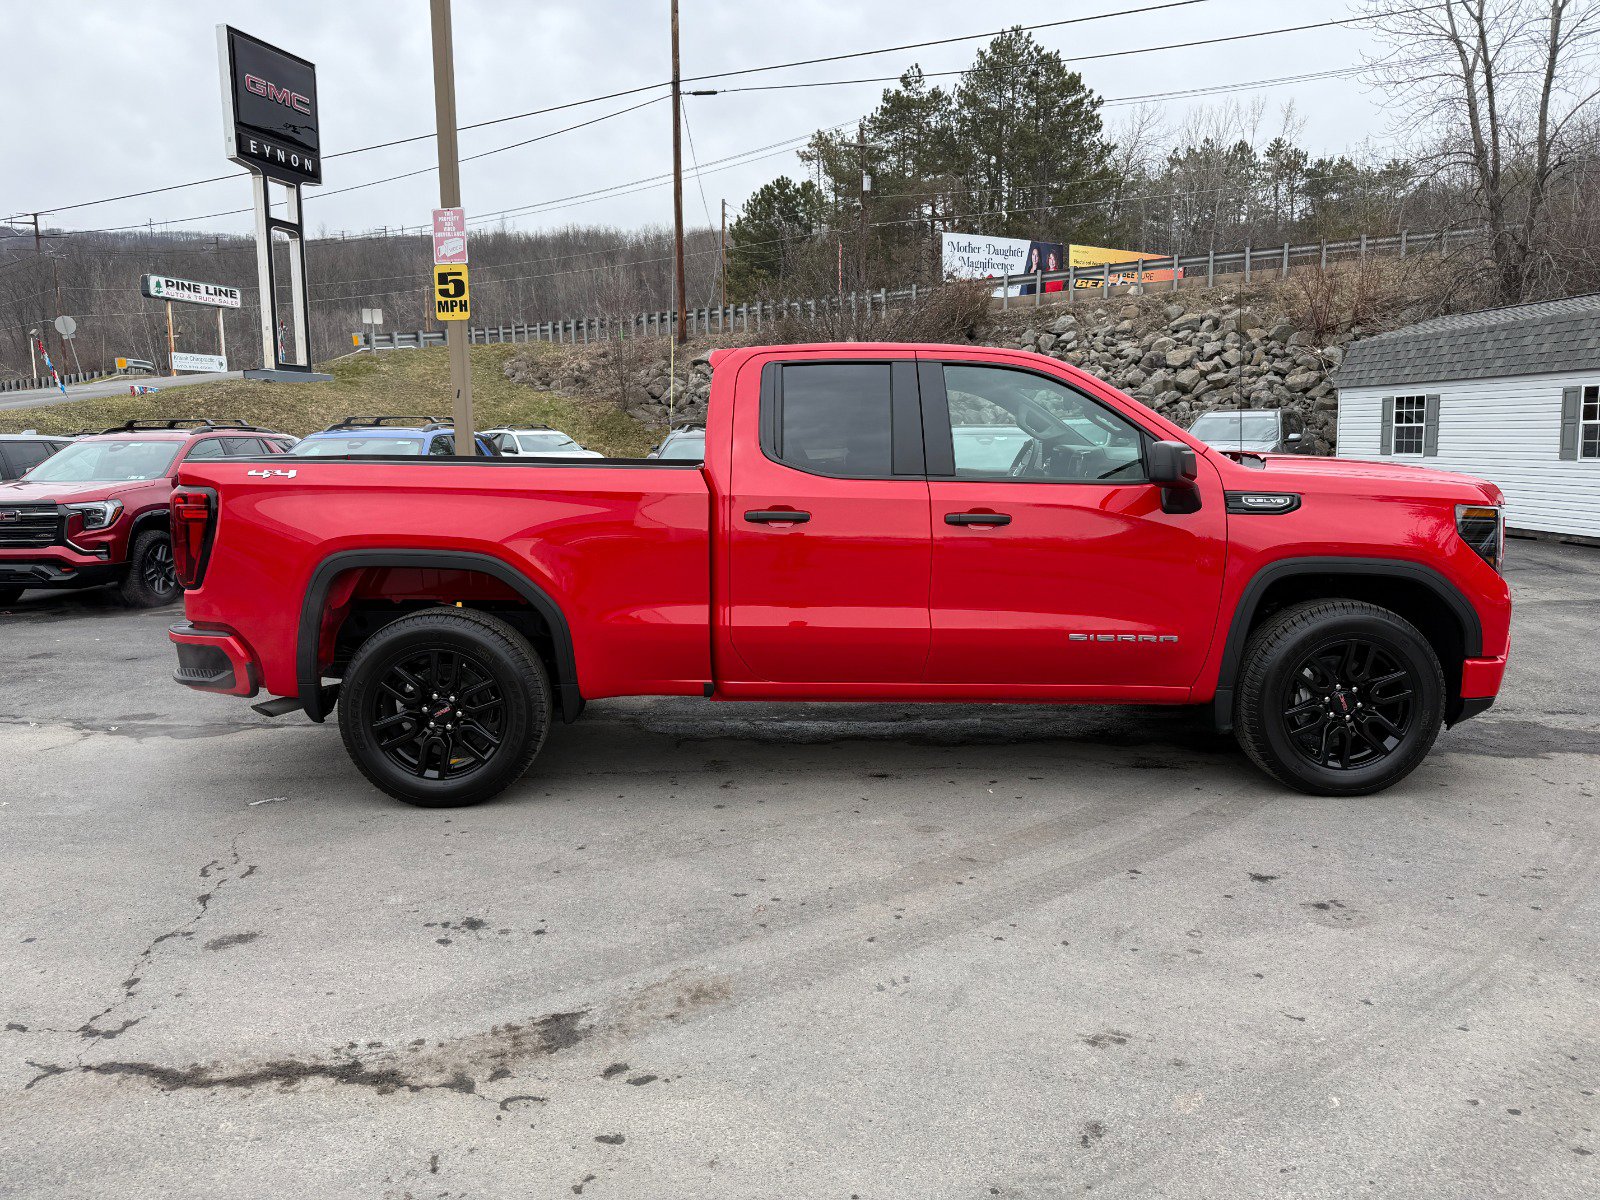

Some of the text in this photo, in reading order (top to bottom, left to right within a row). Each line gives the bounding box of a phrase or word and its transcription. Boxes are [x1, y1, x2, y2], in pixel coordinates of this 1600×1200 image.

[244, 73, 311, 115] GMC
[250, 140, 313, 172] EYNON
[959, 256, 1015, 274] Magnificence
[165, 279, 238, 299] PINE LINE
[437, 271, 466, 298] 5
[165, 291, 185, 299] AUTO
[195, 295, 216, 303] TRUCK
[218, 298, 239, 307] SALES
[438, 300, 468, 313] MPH
[1068, 633, 1179, 643] SIERRA
